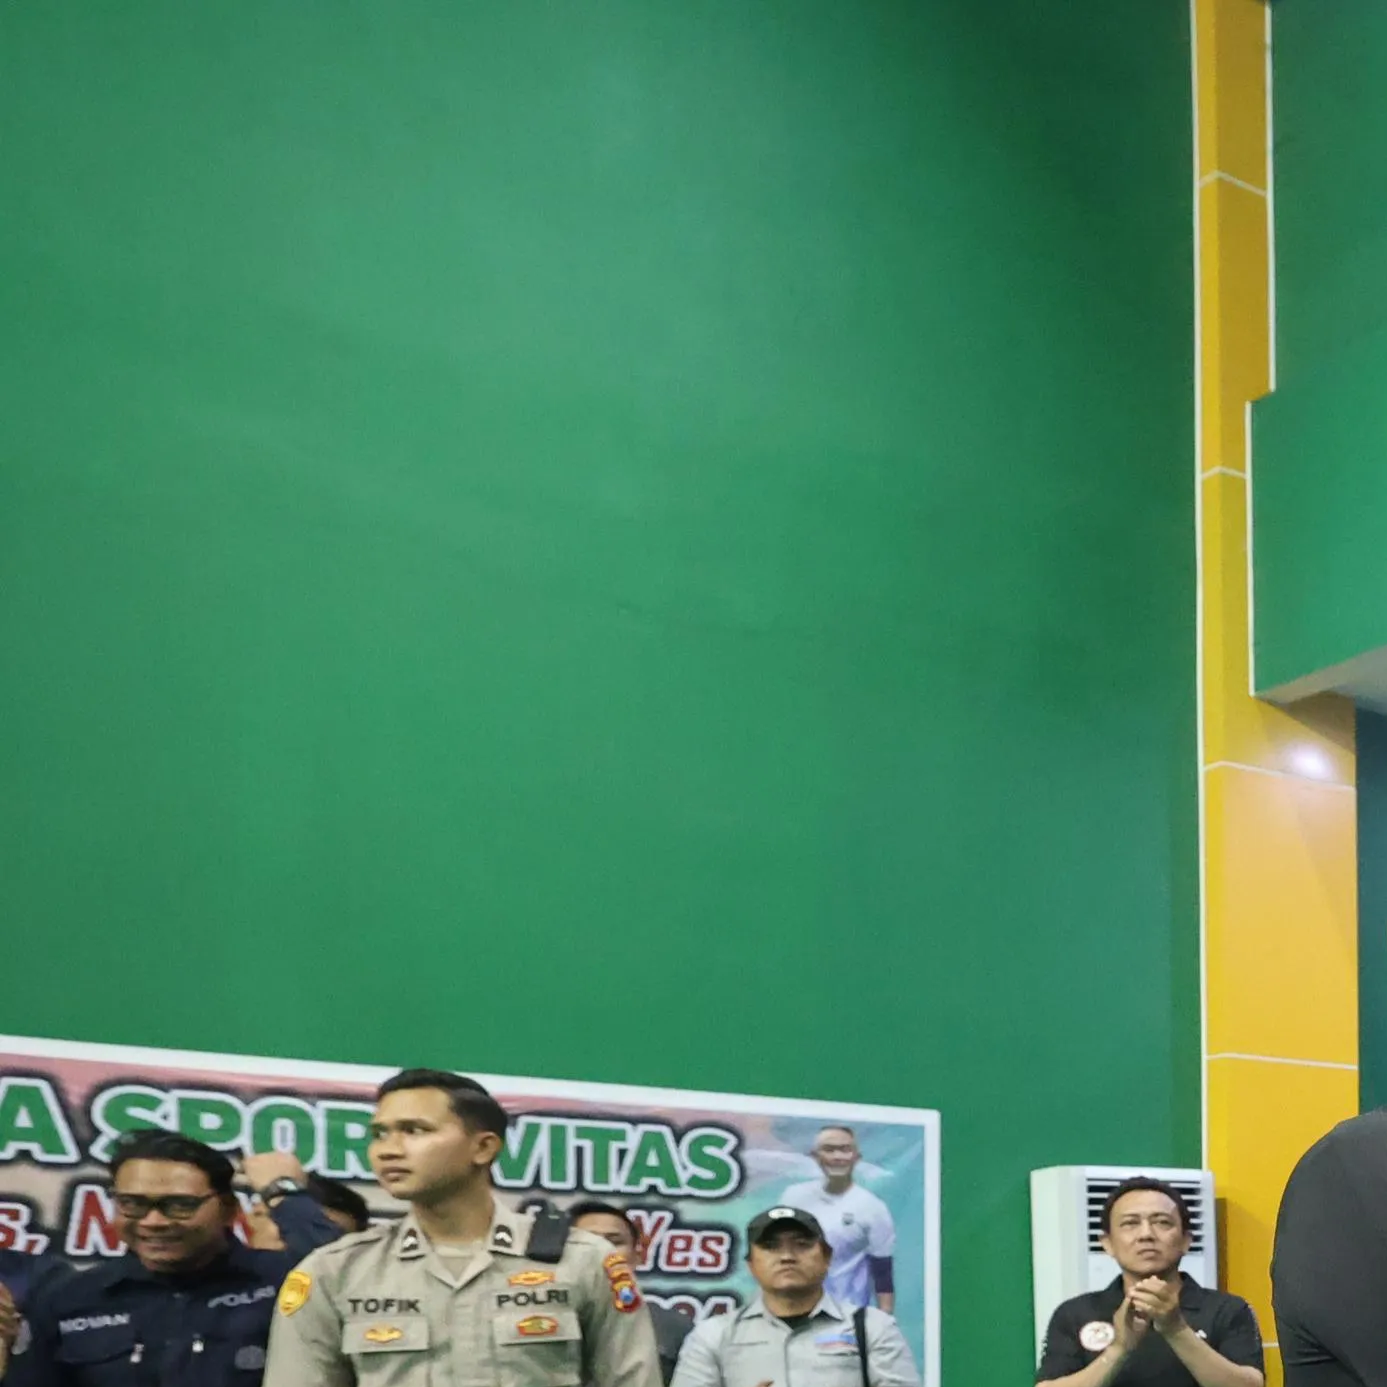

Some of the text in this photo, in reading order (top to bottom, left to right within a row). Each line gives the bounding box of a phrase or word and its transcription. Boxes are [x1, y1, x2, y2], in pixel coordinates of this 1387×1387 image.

[88, 1084, 747, 1198] SPORVITAS
[349, 1289, 570, 1314] TOFIK POLRI
